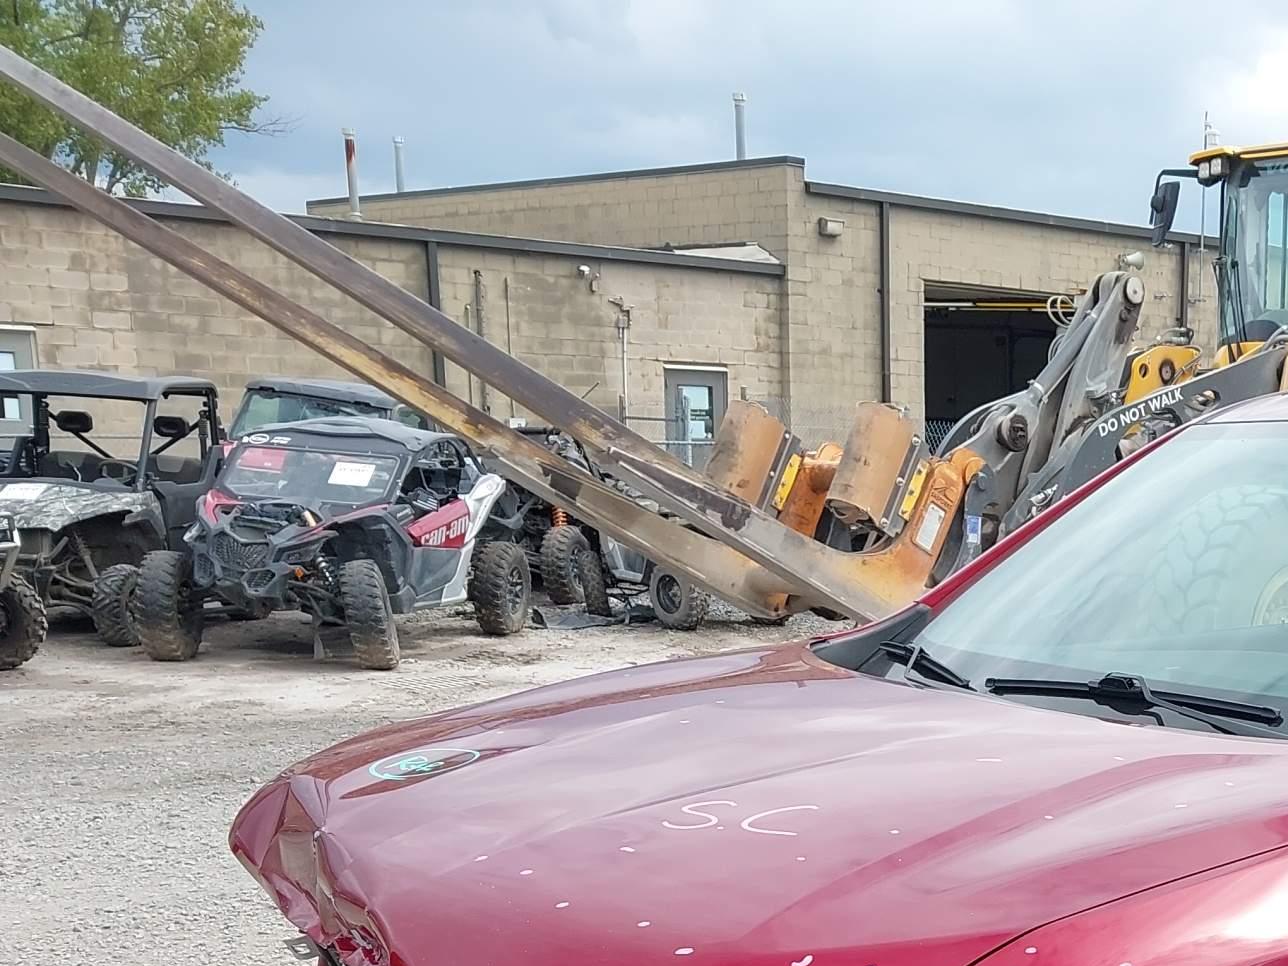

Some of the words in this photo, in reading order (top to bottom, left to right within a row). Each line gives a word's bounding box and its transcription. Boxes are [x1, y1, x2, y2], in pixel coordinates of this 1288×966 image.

[1099, 419, 1118, 437] DO
[1120, 403, 1146, 426] NOT
[1148, 388, 1184, 411] WALK
